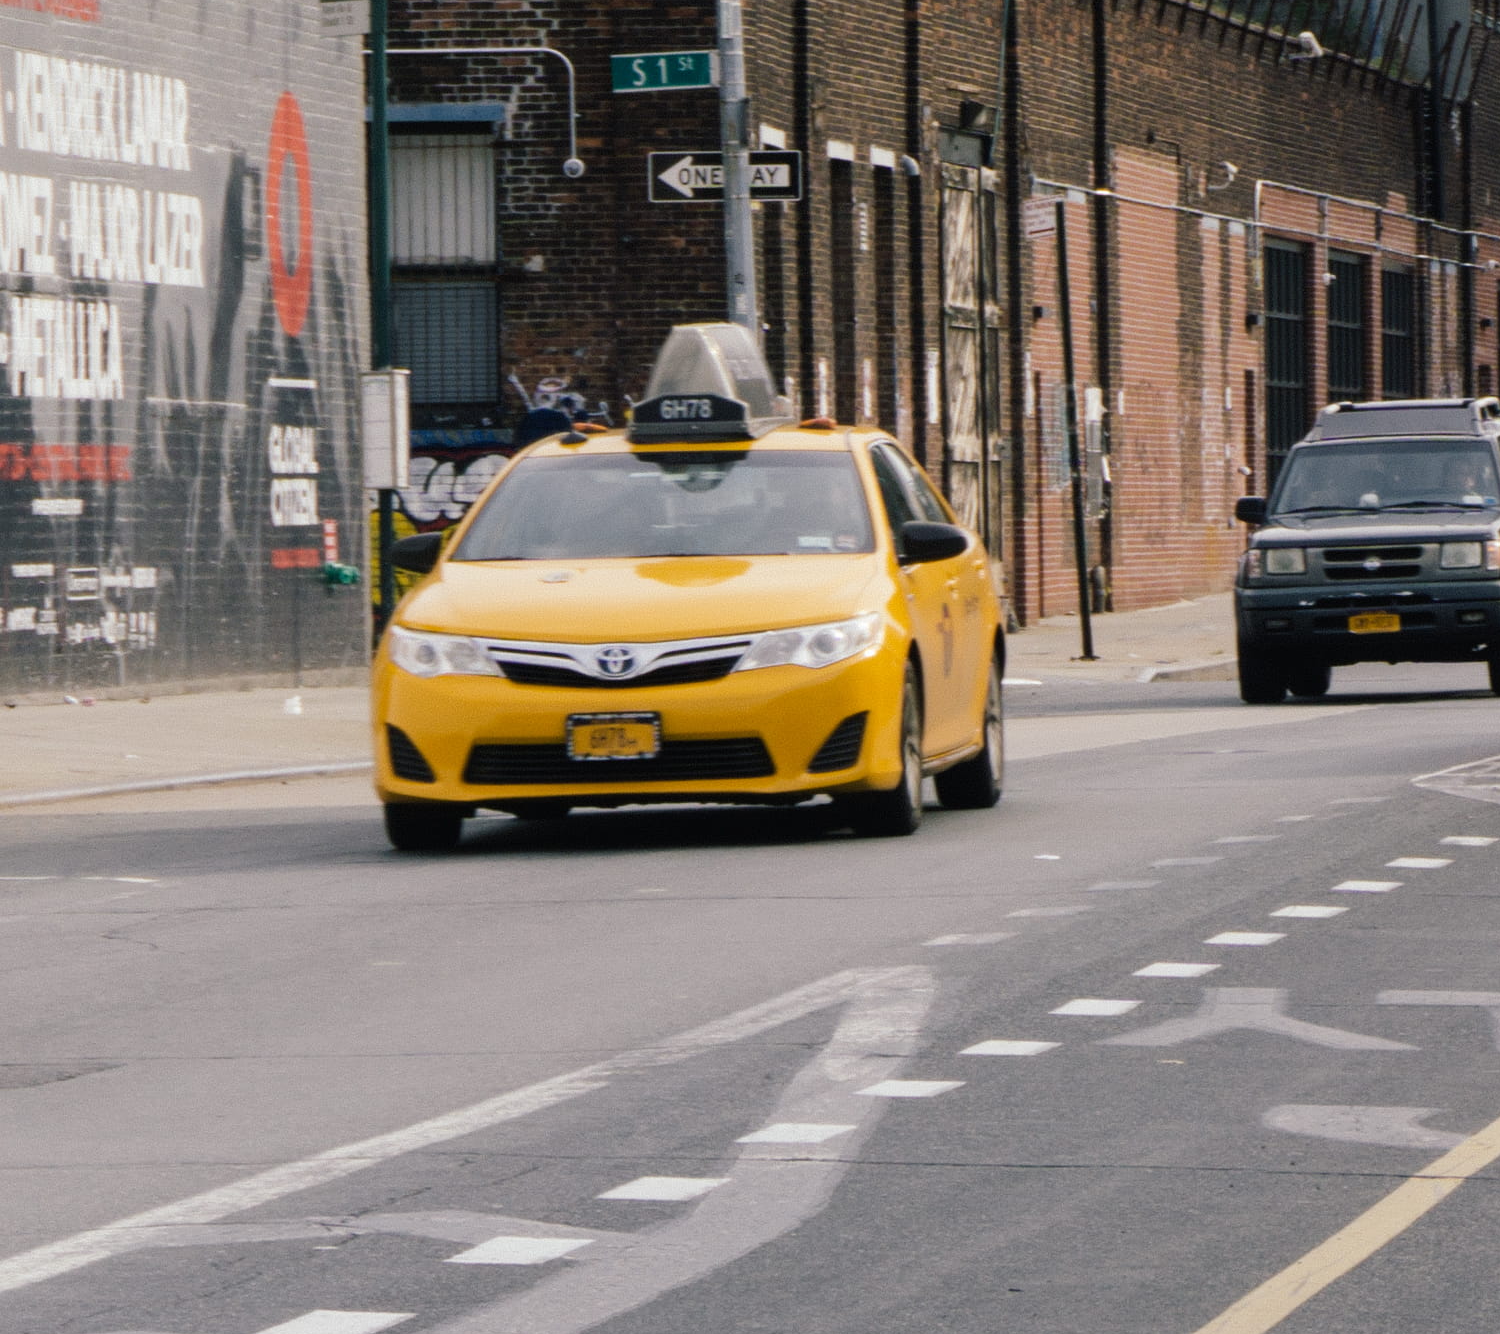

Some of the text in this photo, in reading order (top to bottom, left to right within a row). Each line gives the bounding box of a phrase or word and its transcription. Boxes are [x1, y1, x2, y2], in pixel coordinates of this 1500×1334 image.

[631, 58, 648, 87] S
[656, 57, 669, 85] 1
[119, 67, 192, 171] LAMAR
[677, 166, 780, 186] ONE AY
[660, 399, 713, 419] 6H78
